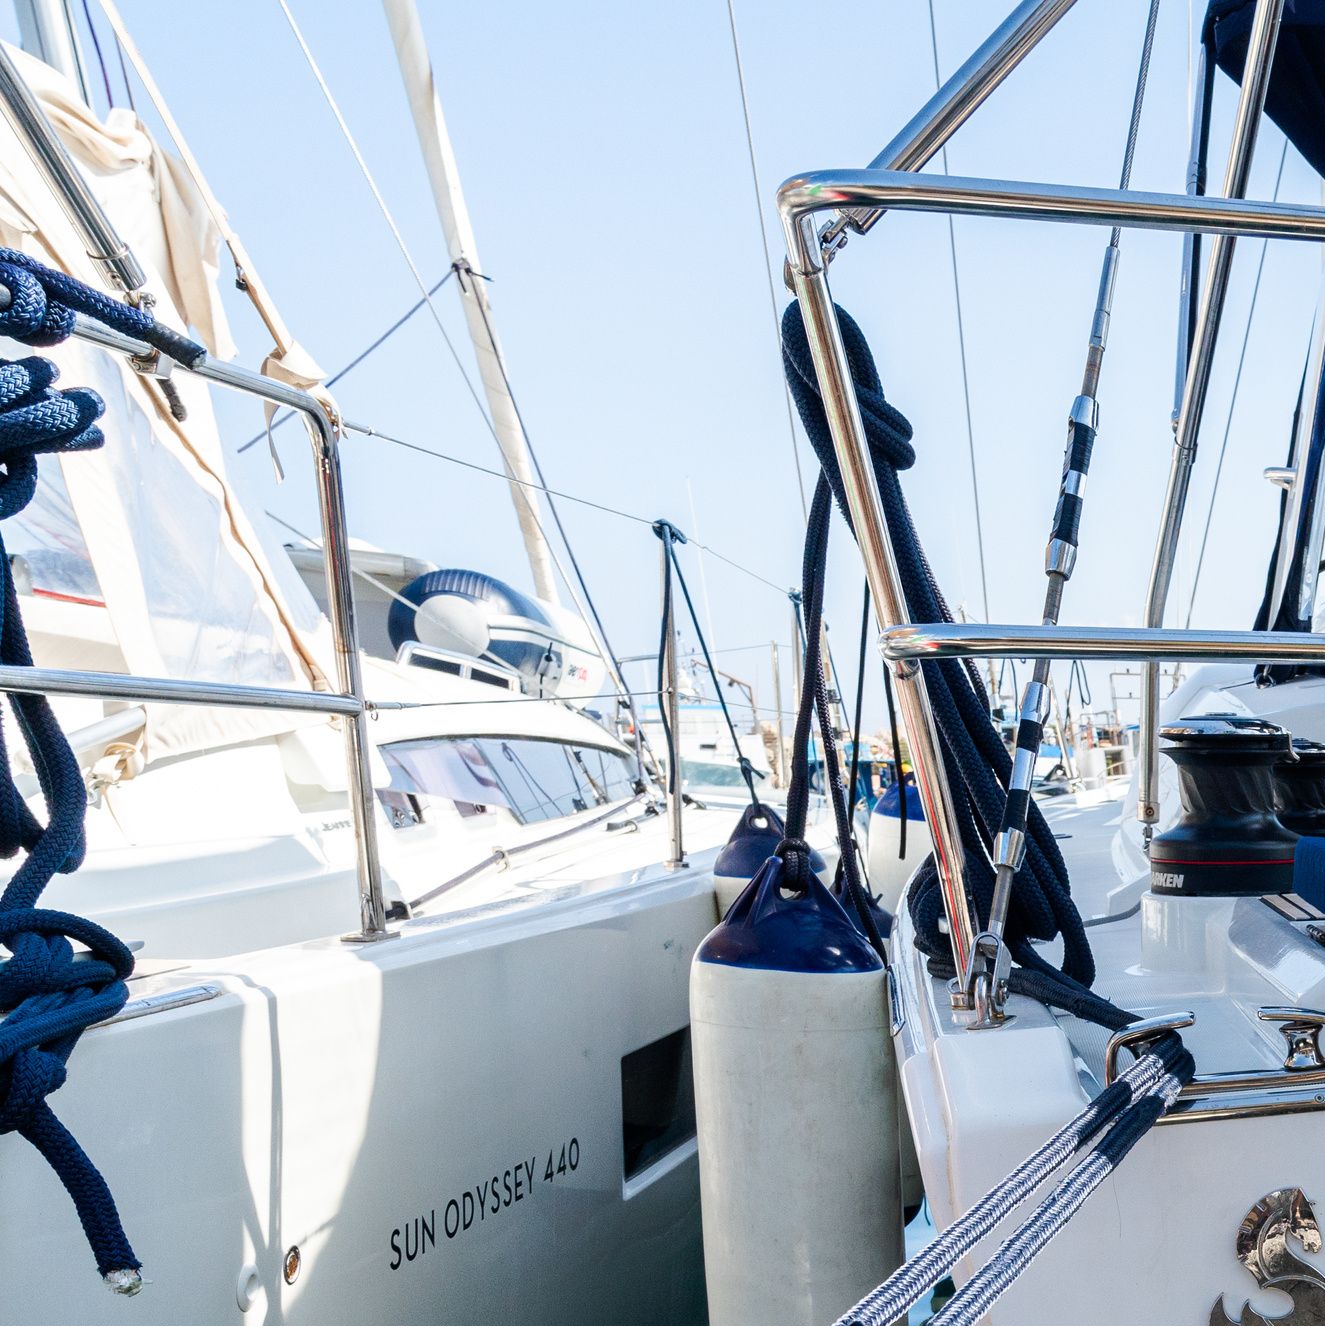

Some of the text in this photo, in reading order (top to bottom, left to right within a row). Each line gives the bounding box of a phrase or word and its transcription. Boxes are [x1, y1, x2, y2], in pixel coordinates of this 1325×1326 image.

[390, 1137, 580, 1270] SUN ODYSSEY 440
